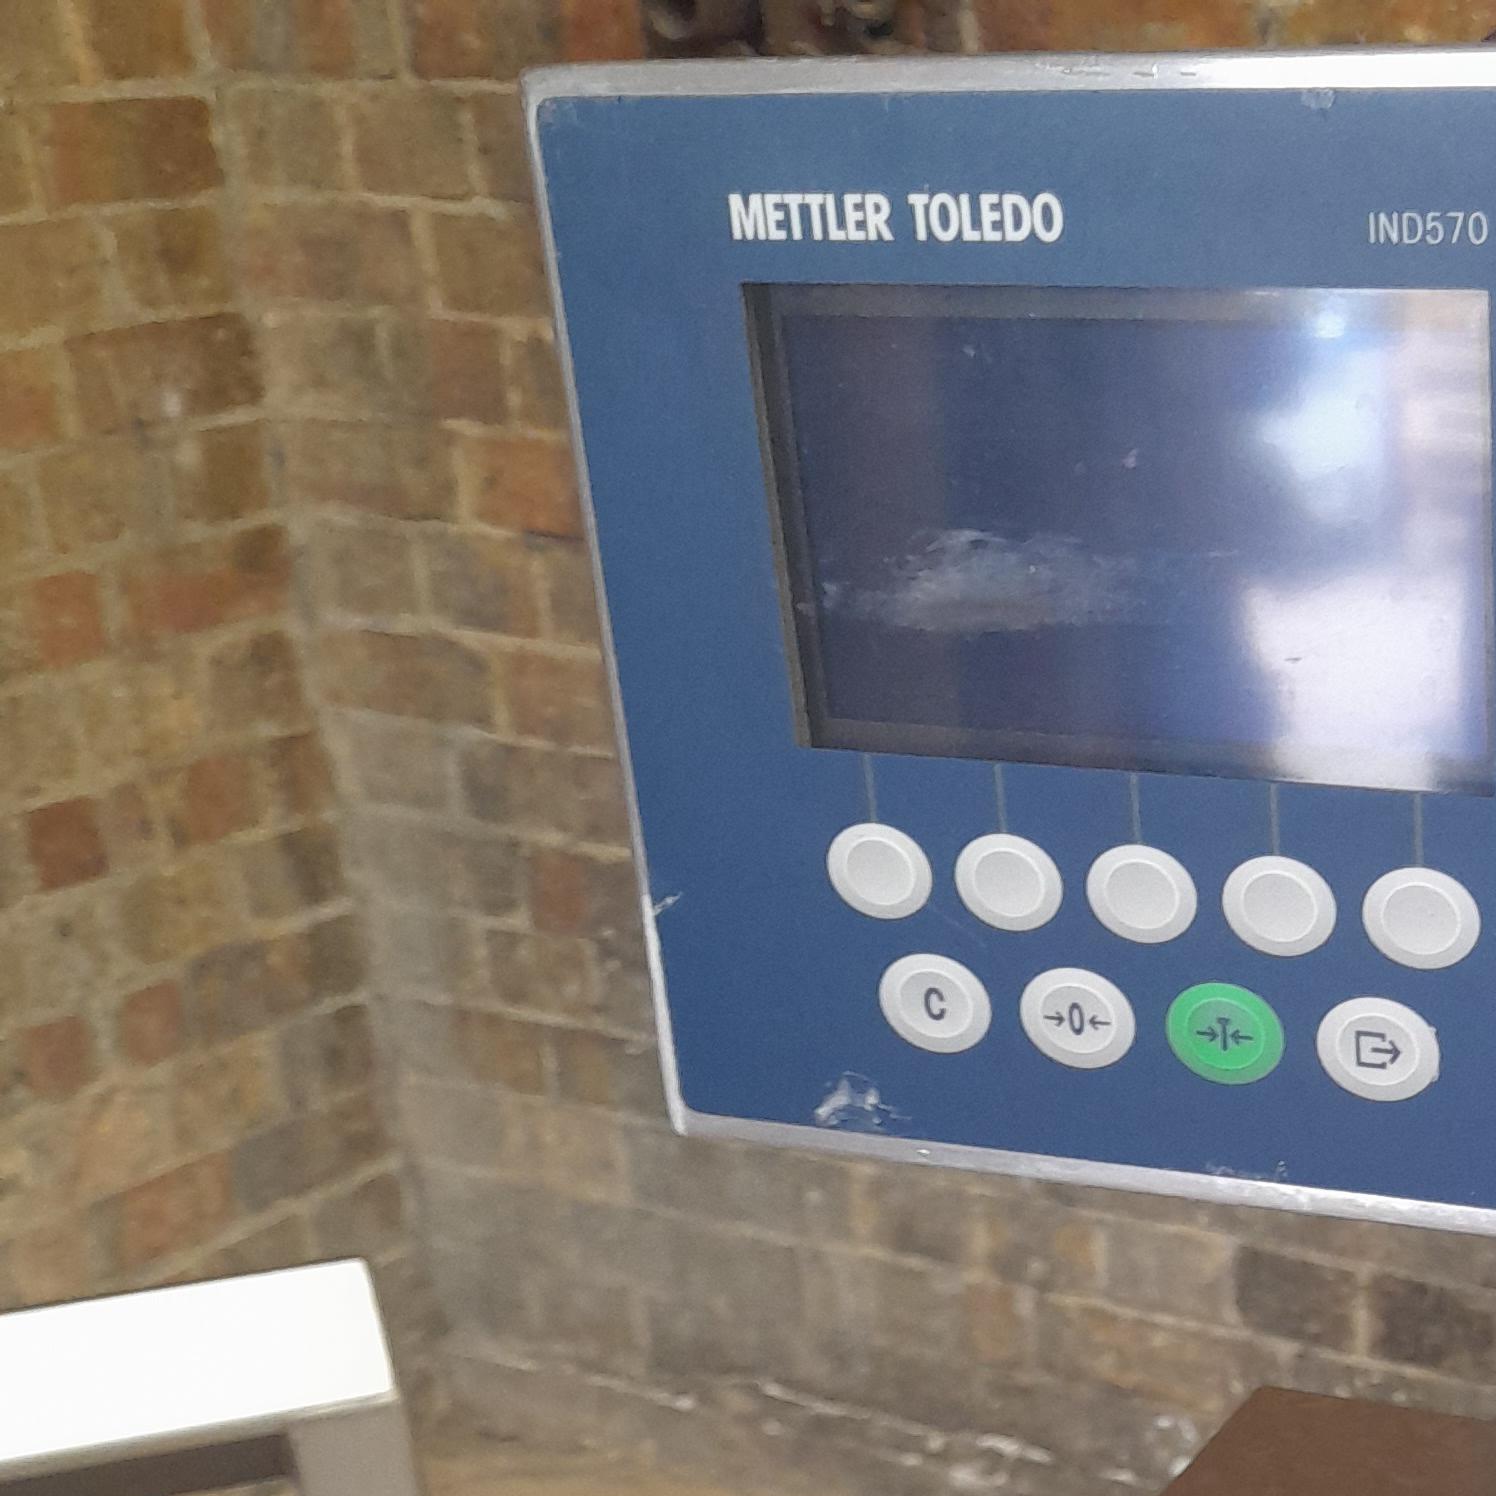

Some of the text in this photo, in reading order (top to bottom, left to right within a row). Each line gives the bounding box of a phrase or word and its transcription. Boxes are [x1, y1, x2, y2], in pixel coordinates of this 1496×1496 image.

[728, 192, 1064, 242] METTLER TOLEDO
[1368, 211, 1488, 245] IND570
[924, 987, 946, 1021] C
